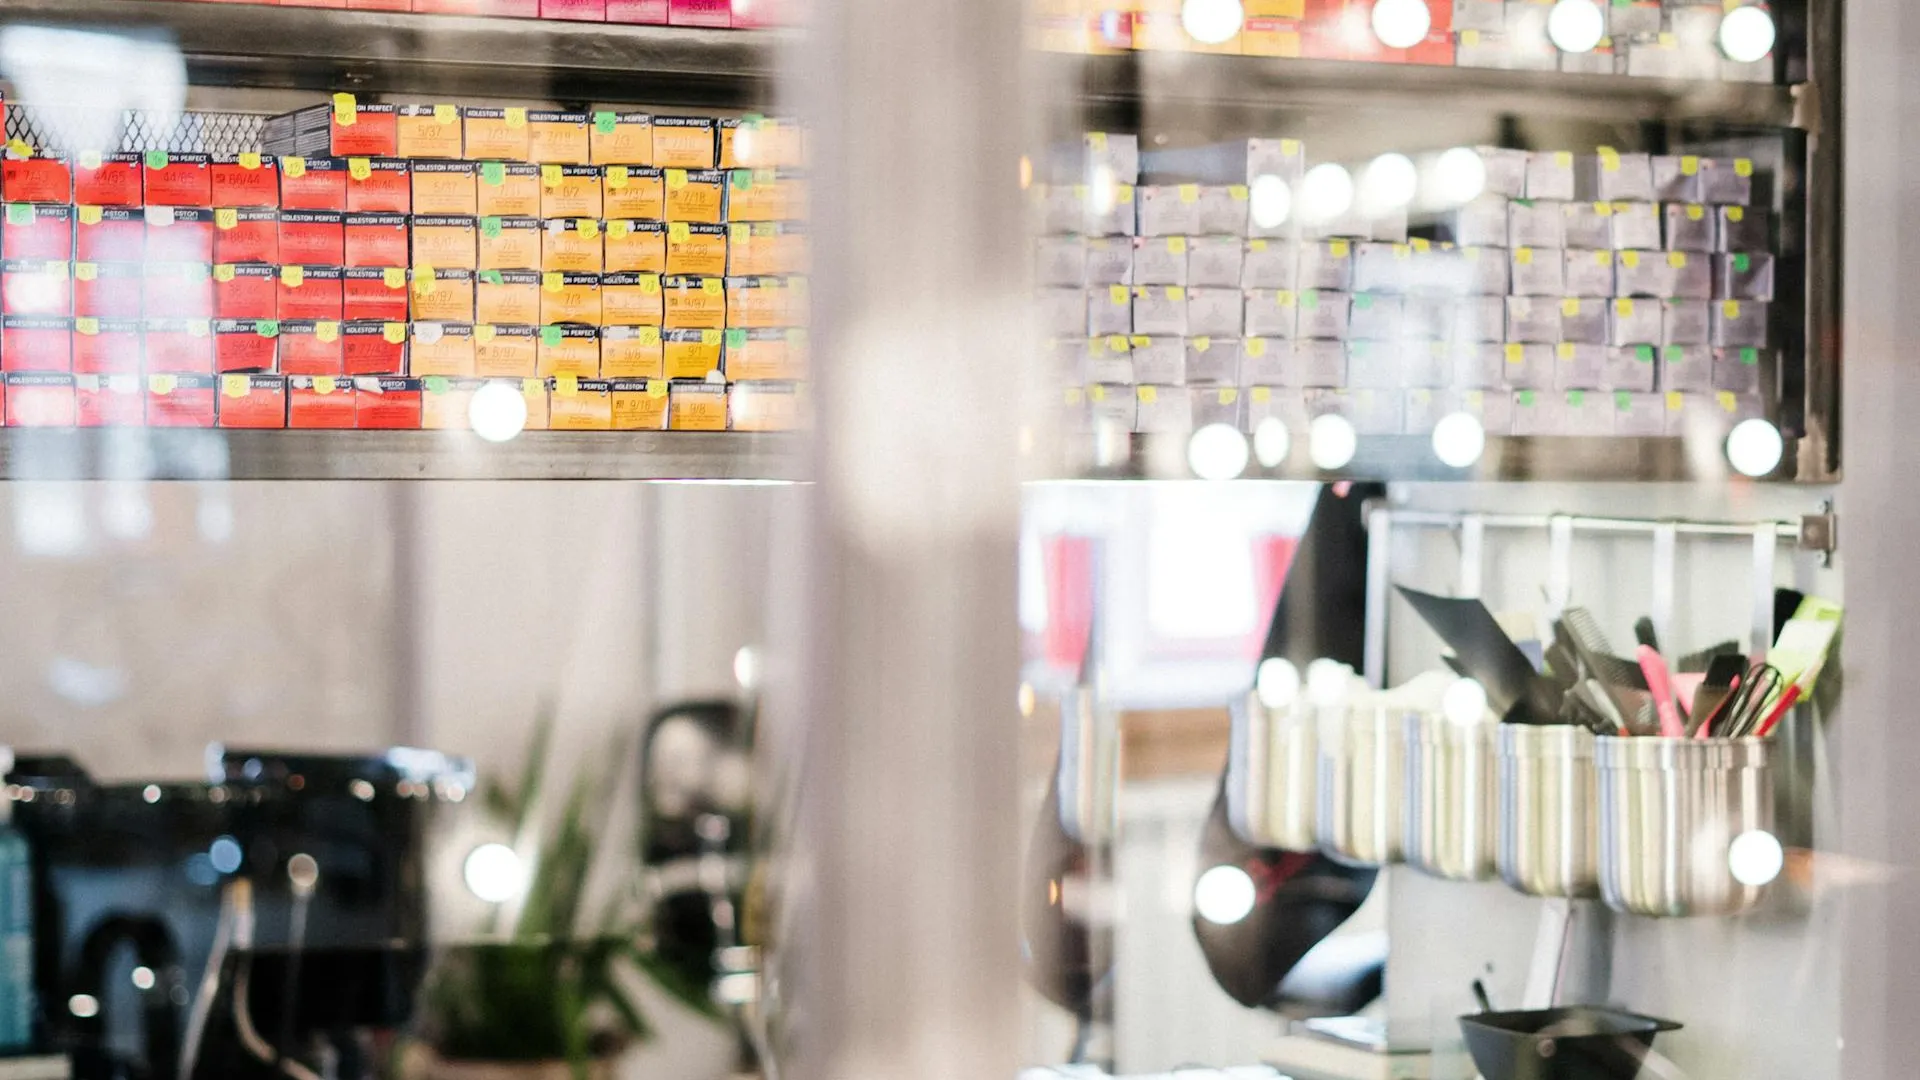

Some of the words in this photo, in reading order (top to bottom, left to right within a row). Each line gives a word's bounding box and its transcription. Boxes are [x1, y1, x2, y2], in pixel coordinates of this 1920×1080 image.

[368, 104, 393, 112] PERFECT
[468, 110, 499, 118] KOLESTON
[530, 113, 560, 121] KOLESTON
[561, 114, 586, 122] PERFECT
[686, 118, 711, 126] PERFECT
[381, 161, 406, 169] PERFECT
[415, 163, 447, 171] KOLESTON
[448, 164, 473, 172] PERFECT
[512, 166, 537, 174] PERFECT
[572, 168, 597, 176] PERFECT
[635, 168, 660, 176] PERFECT
[697, 174, 721, 182] PERFECT
[40, 208, 68, 216] PERFECT
[249, 213, 275, 221] PERFECT
[281, 214, 313, 222] KOLESTON
[314, 214, 341, 222] PERFECT
[346, 216, 378, 224] KOLESTON
[379, 216, 405, 224] PERFECT
[513, 219, 538, 227] PERFECT
[637, 223, 661, 231] PERFECT
[699, 225, 724, 233] PERFECT
[247, 267, 273, 275] PERFECT
[313, 269, 339, 277] PERFECT
[346, 270, 378, 278] KOLESTON
[444, 270, 470, 279] PERFECT
[512, 274, 537, 283] PERFECT
[573, 276, 598, 284] PERFECT
[346, 326, 378, 334] KOLESTON
[445, 326, 471, 335] PERFECT
[507, 327, 532, 335] PERFECT
[571, 328, 596, 336] PERFECT
[256, 379, 282, 388] PERFECT
[584, 383, 609, 391] PERFECT
[614, 382, 644, 391] KOLESTON
